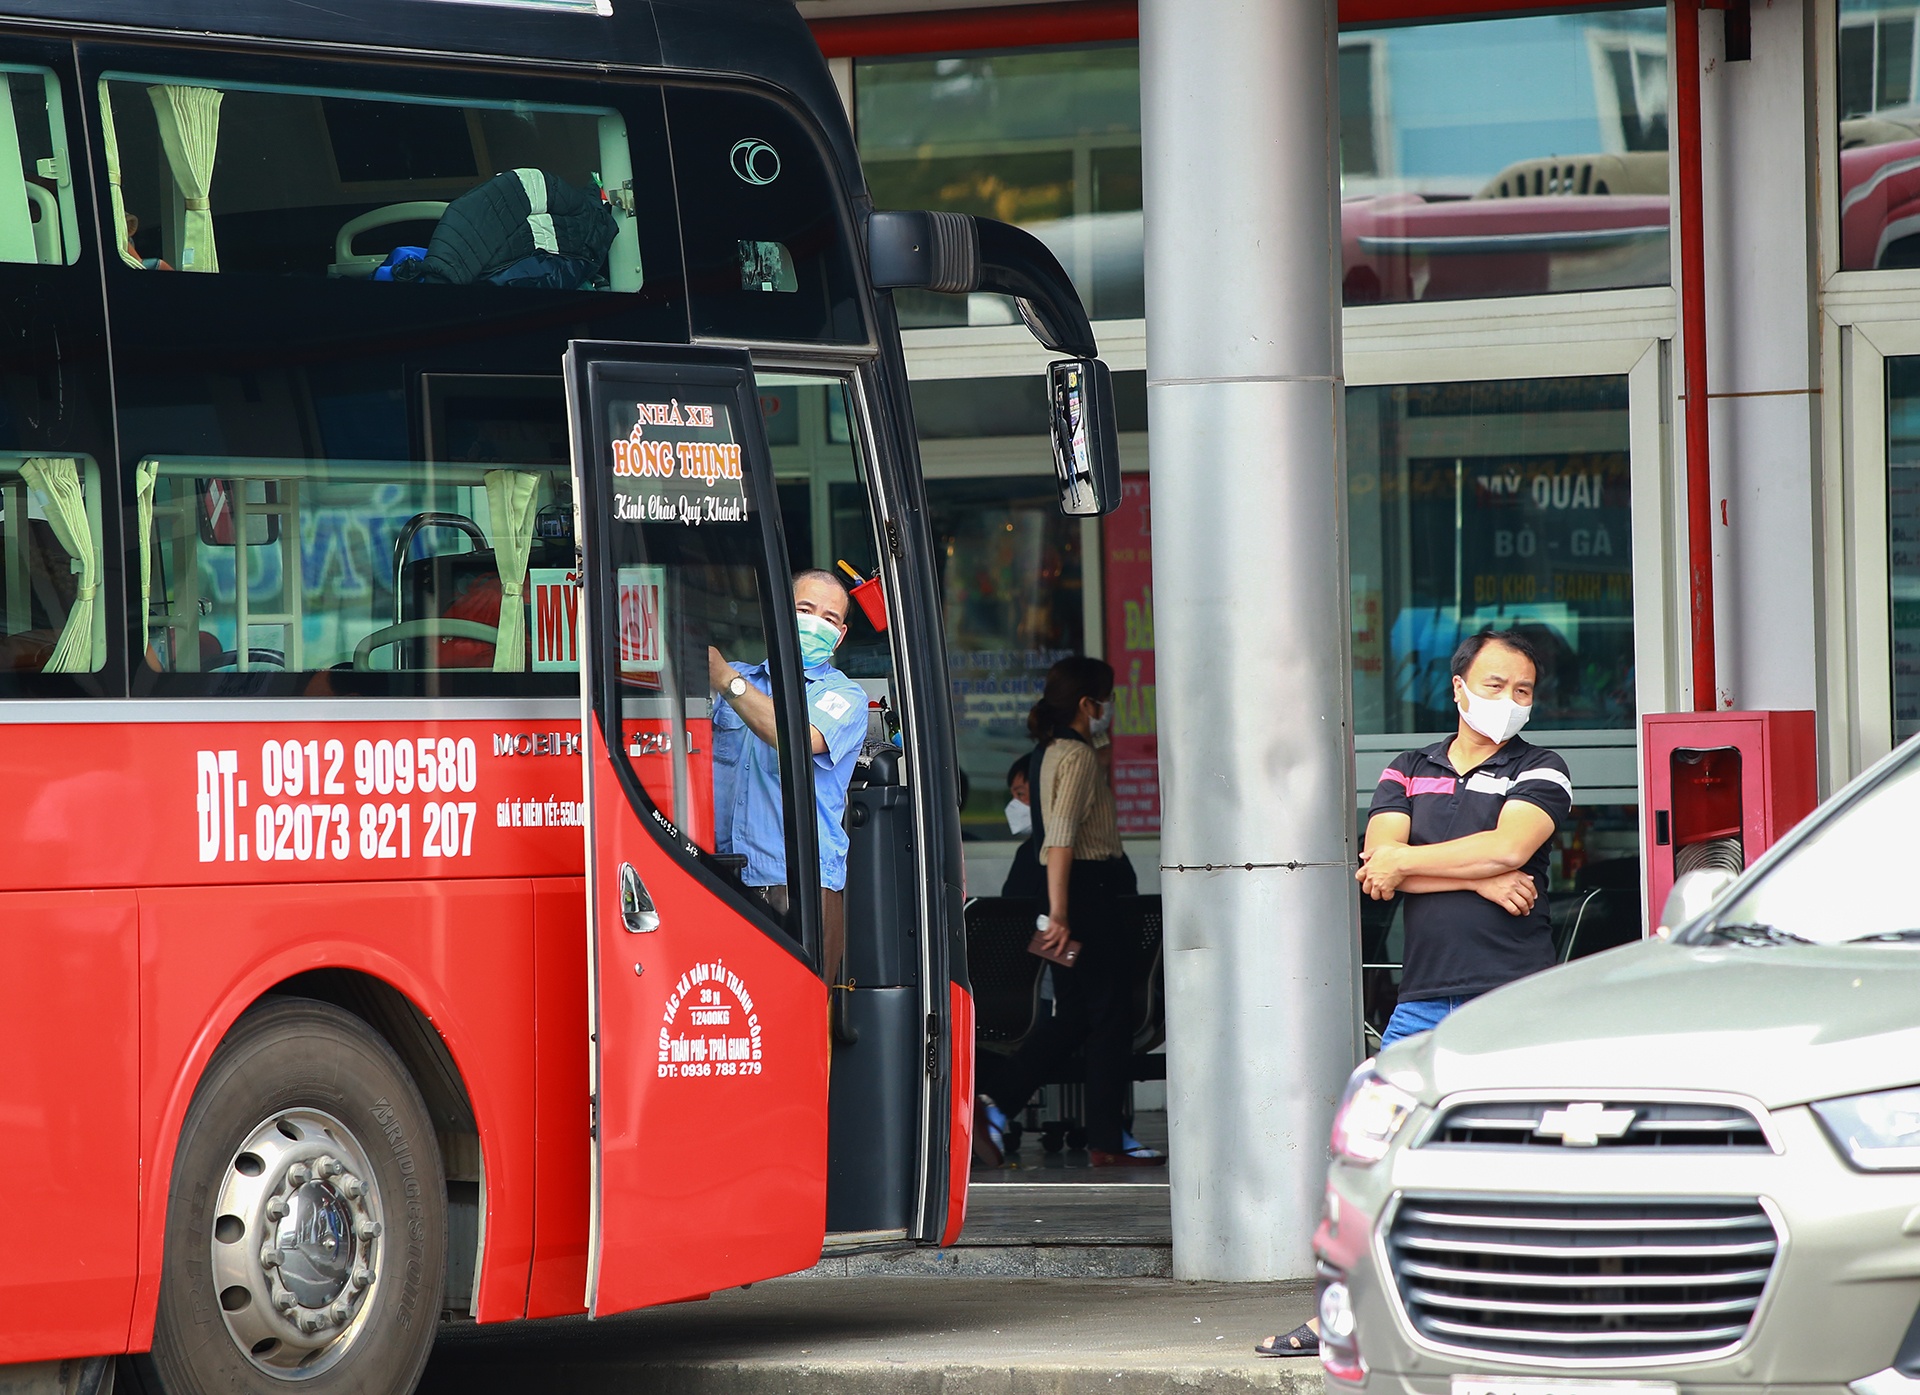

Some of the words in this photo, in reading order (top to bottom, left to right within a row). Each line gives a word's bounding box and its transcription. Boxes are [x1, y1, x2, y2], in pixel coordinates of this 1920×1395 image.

[637, 398, 684, 427] NHÀ
[685, 404, 714, 428] XE
[612, 423, 675, 478] HỒNG
[676, 441, 743, 487] THỊNH
[613, 493, 646, 521] Kính
[647, 494, 677, 521] Chào
[678, 494, 702, 526] Quý
[703, 495, 741, 522] Khách
[536, 571, 579, 662] MỸ
[620, 585, 659, 661] NH
[493, 732, 583, 757] MOBIHO
[197, 750, 248, 863] ĐT:
[262, 739, 345, 798] 0912
[497, 797, 511, 827] GIÁ
[511, 797, 522, 827] VÉ
[522, 797, 543, 827] NIÊM
[255, 803, 350, 862] 02073
[359, 802, 411, 860] 821
[422, 801, 478, 858] 207
[689, 962, 710, 986] VẬN
[710, 958, 726, 984] TẢI
[700, 988, 712, 1004] 38
[712, 991, 721, 1006] N
[691, 1010, 730, 1026] 12400KG
[728, 1037, 750, 1061] GIANG
[657, 1063, 679, 1078] ĐT:
[681, 1063, 711, 1077] 0936
[715, 1062, 737, 1076] 788
[739, 1061, 762, 1075] 279
[369, 1096, 426, 1333] BRIDGESTONE
